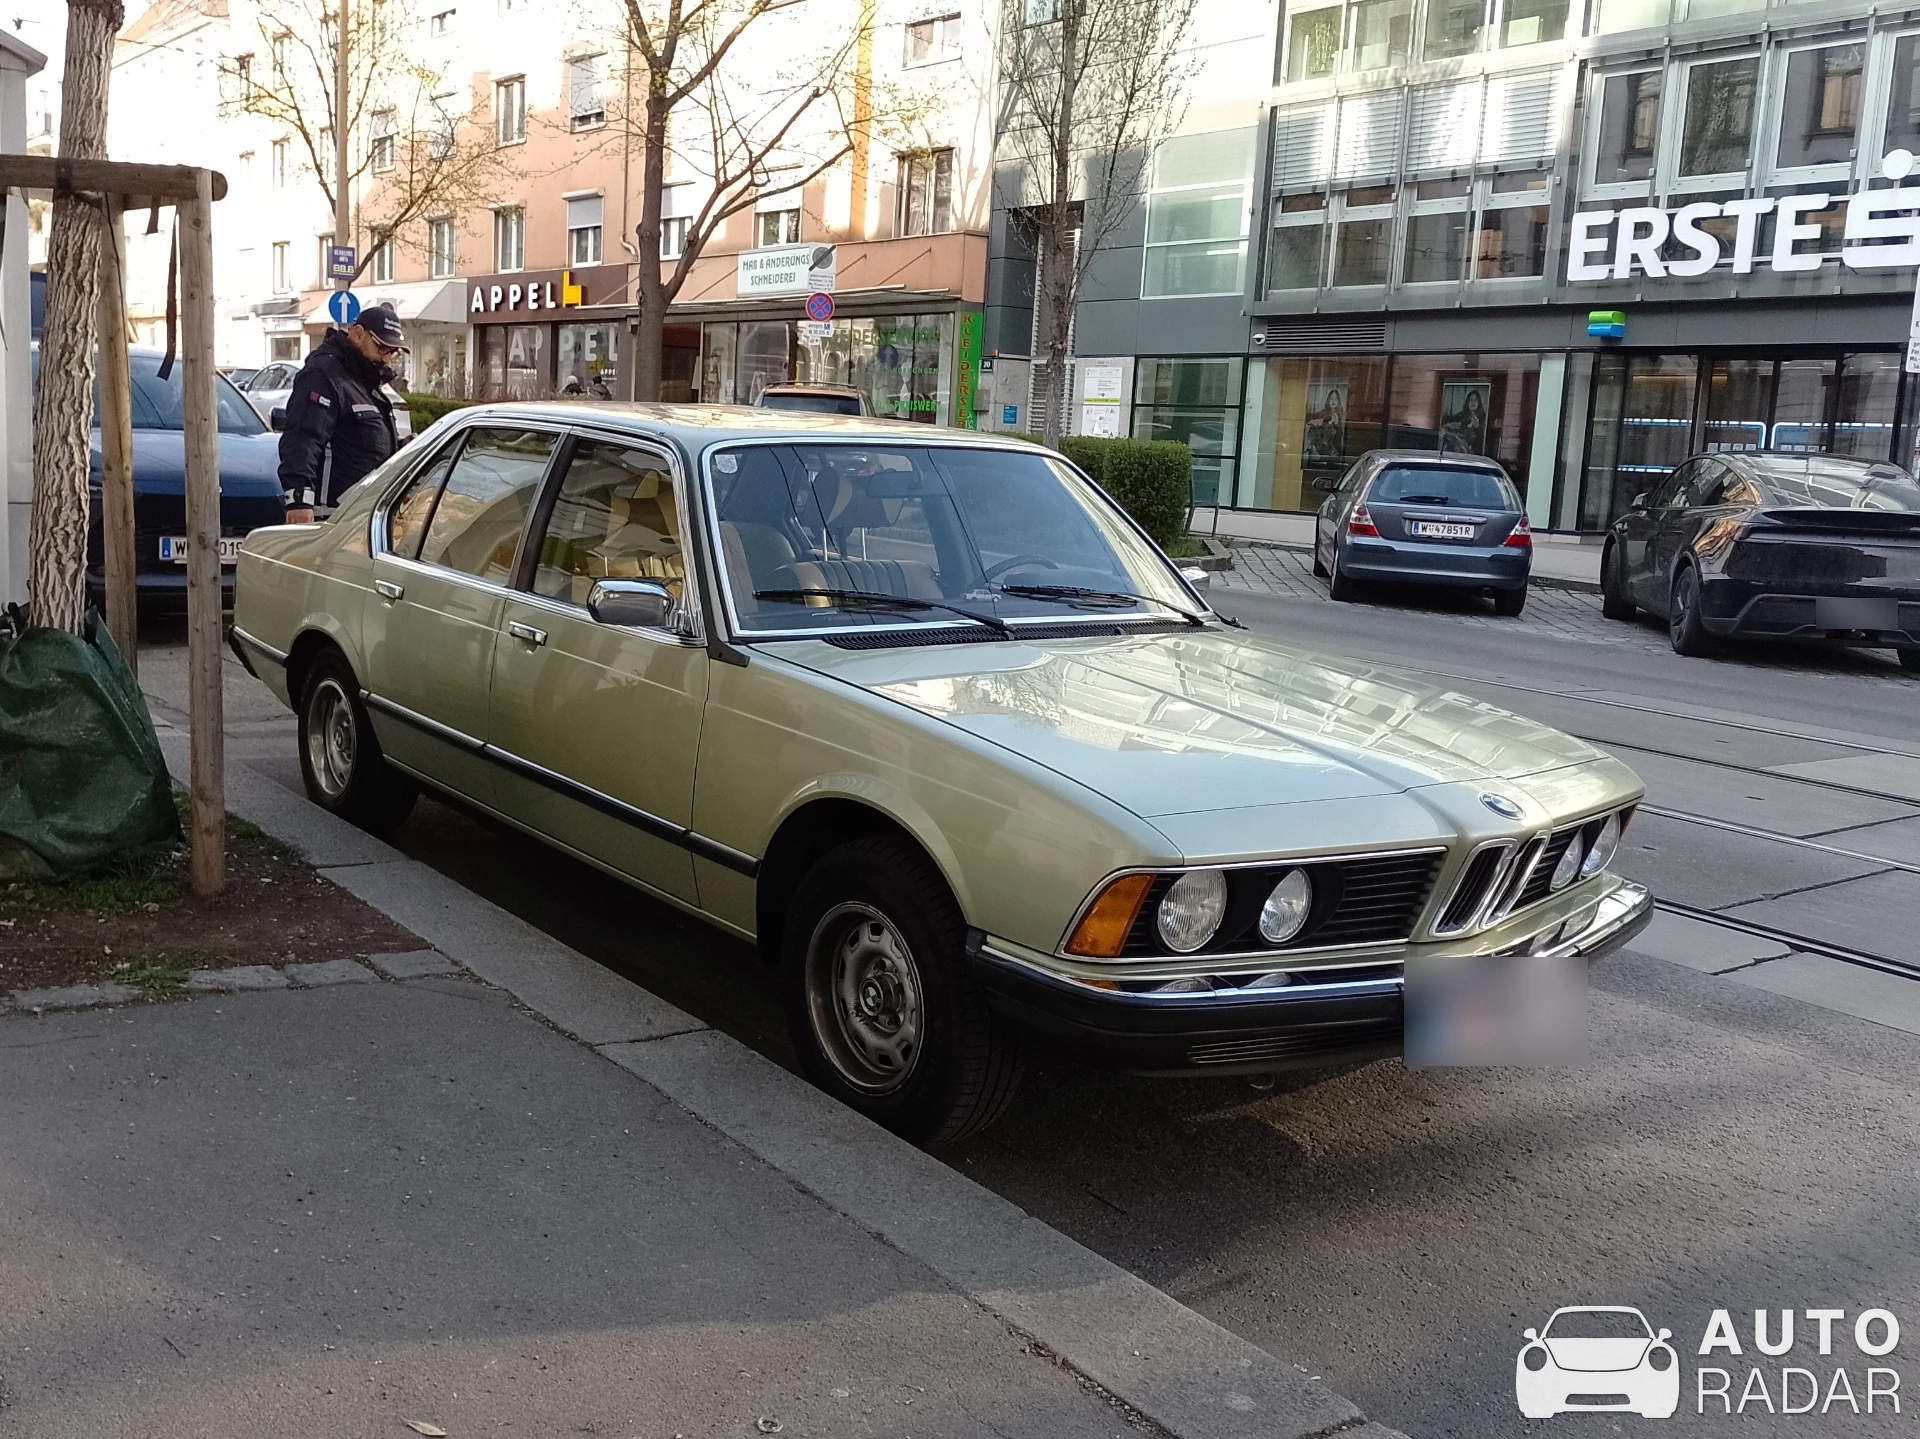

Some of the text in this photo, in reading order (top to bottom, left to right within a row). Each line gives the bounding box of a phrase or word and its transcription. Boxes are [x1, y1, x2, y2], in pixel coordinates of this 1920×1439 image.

[1567, 193, 1830, 281] ERSTE
[765, 254, 810, 270] ÄNDERUNGS
[750, 272, 796, 286] SCHNEIDEREI
[471, 281, 556, 312] APPEL
[982, 361, 991, 369] 20
